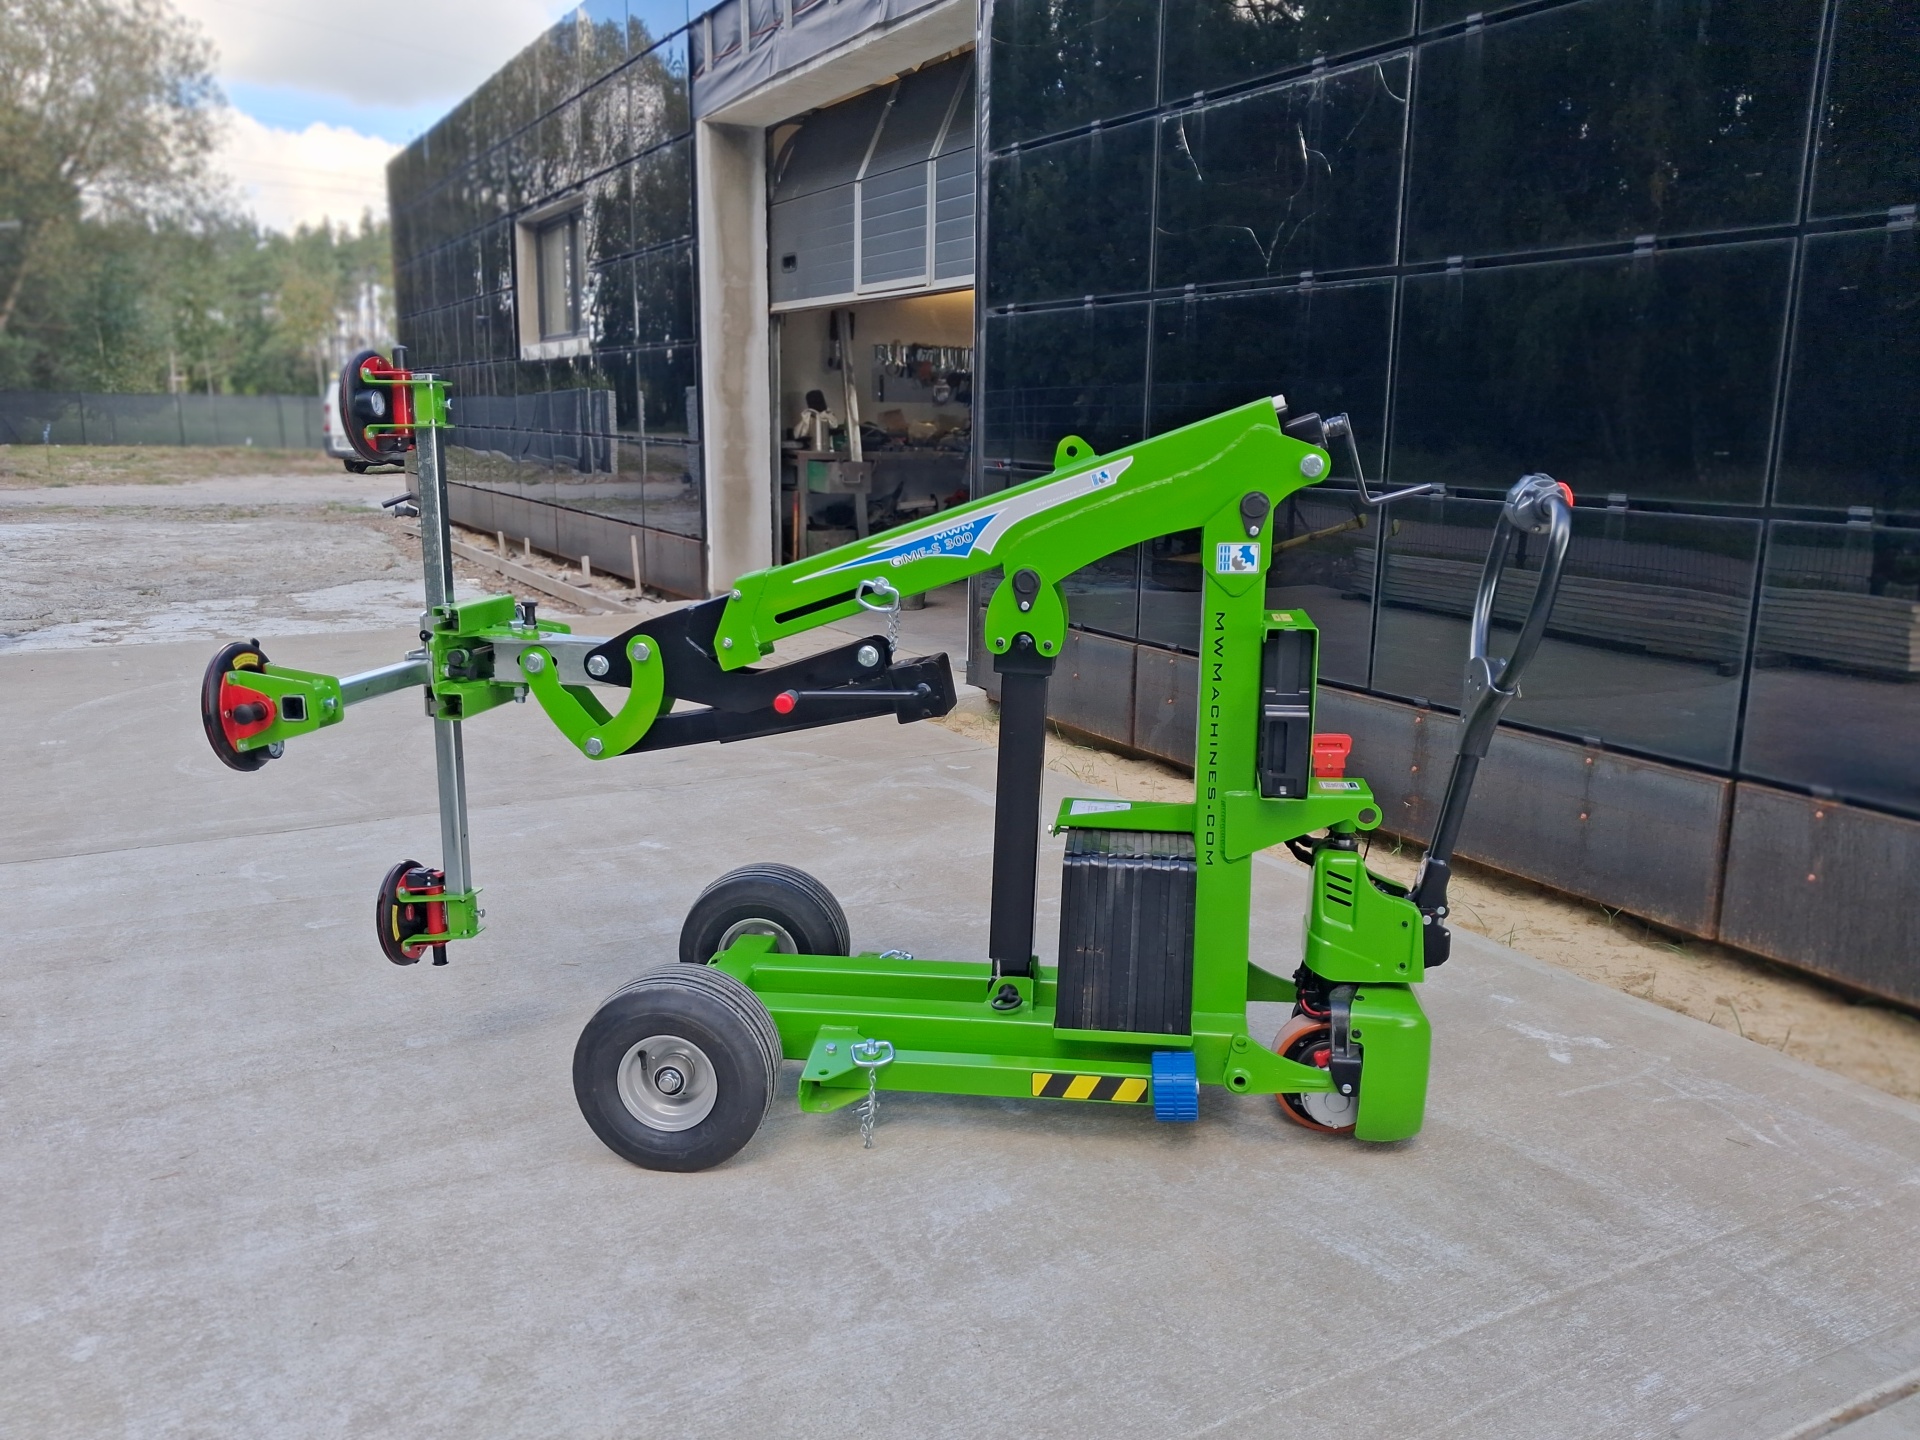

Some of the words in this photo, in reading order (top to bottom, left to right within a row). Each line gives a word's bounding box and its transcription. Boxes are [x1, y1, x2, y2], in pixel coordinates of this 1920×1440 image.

[934, 522, 974, 541] MWM
[890, 542, 941, 567] GME-S
[944, 532, 973, 550] 300
[1205, 612, 1226, 866] MWMACHINES.COM
